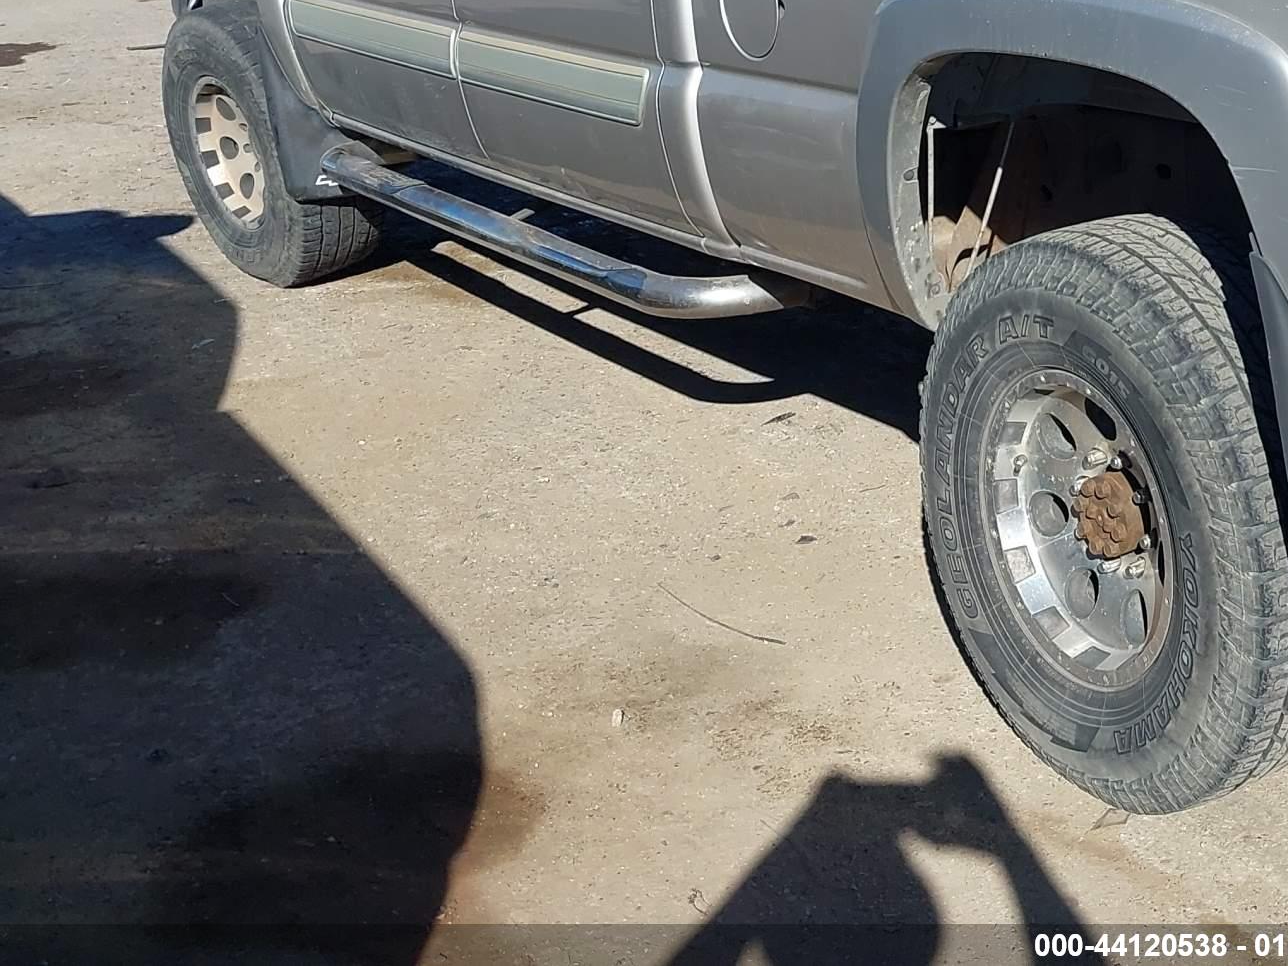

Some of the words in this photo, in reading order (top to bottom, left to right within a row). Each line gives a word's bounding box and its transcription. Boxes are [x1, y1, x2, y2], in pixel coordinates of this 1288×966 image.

[934, 334, 989, 619] GEOLANDAR
[998, 314, 1055, 344] A/T
[1113, 533, 1199, 755] YOKOHAMA
